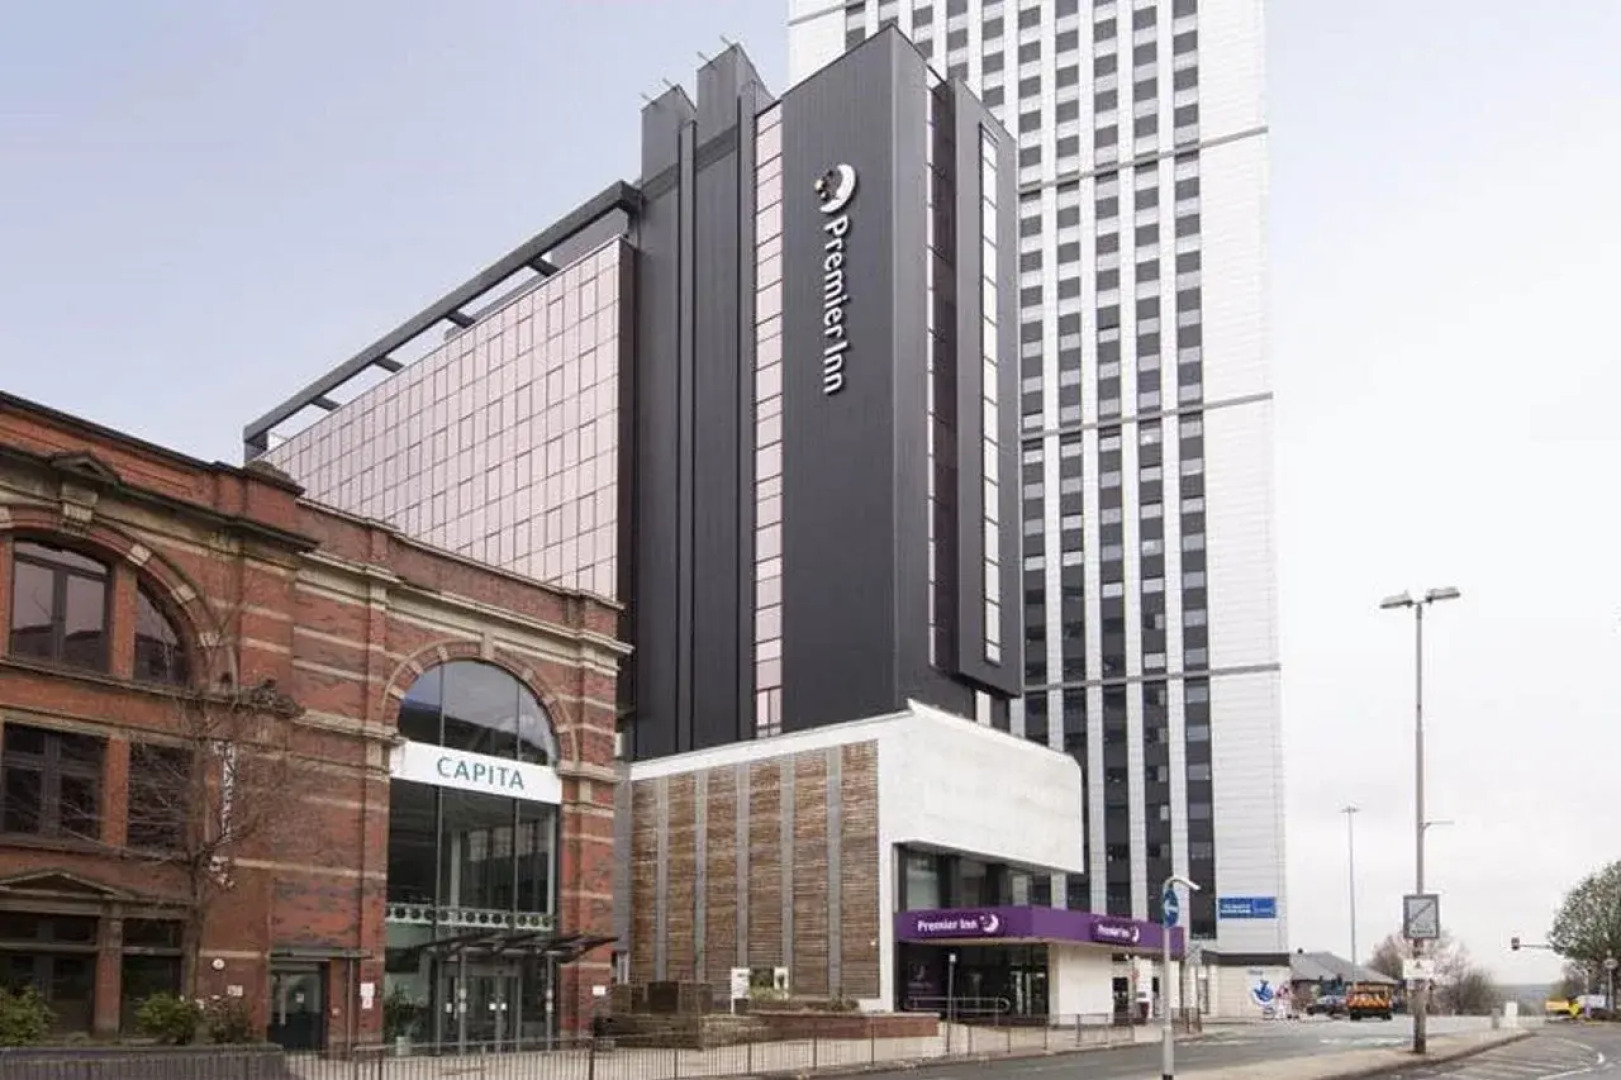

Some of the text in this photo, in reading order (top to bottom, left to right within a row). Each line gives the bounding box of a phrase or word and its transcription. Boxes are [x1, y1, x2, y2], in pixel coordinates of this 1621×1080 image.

[823, 215, 849, 395] Premier Inn
[436, 756, 525, 791] CAPITA
[917, 918, 978, 932] Premier Inn
